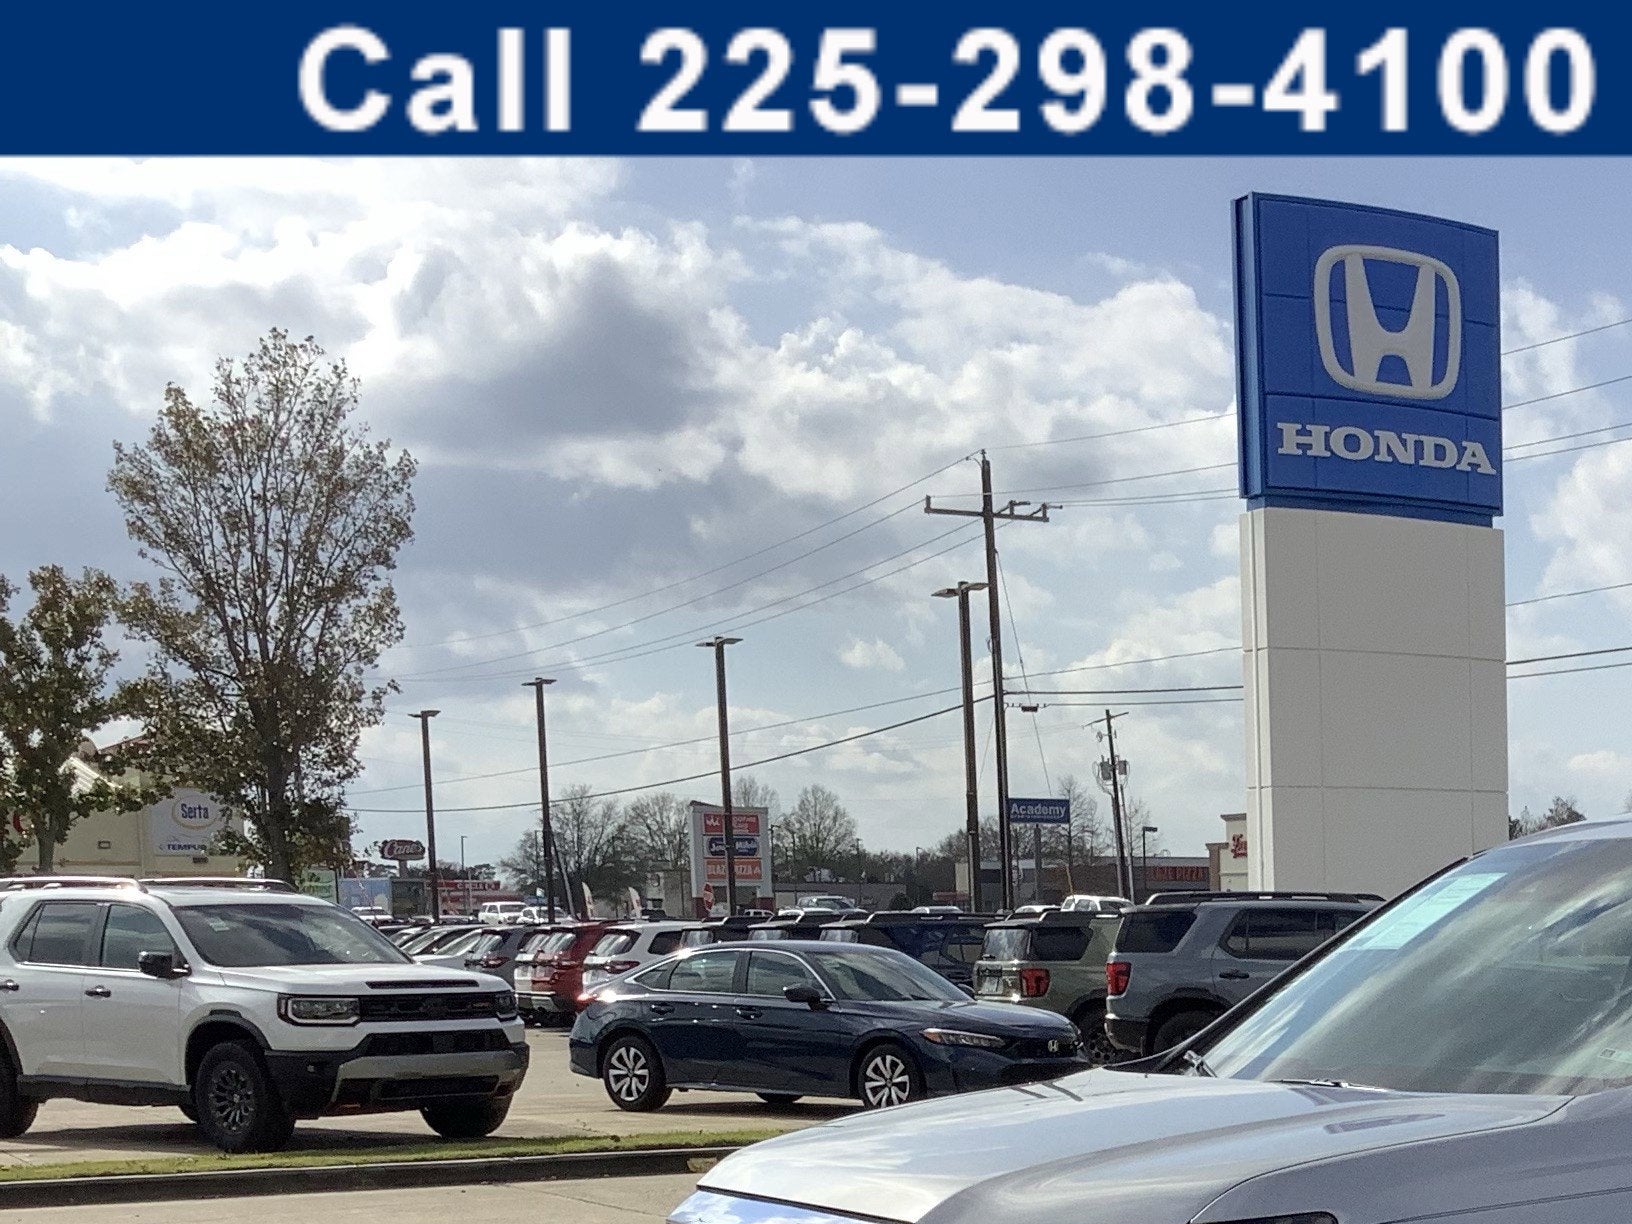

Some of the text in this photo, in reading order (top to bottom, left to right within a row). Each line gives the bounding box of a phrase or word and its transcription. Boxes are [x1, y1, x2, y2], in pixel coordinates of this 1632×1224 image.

[1277, 422, 1497, 475] HONDA
[180, 803, 209, 819] Serta
[1011, 803, 1066, 818] Academy
